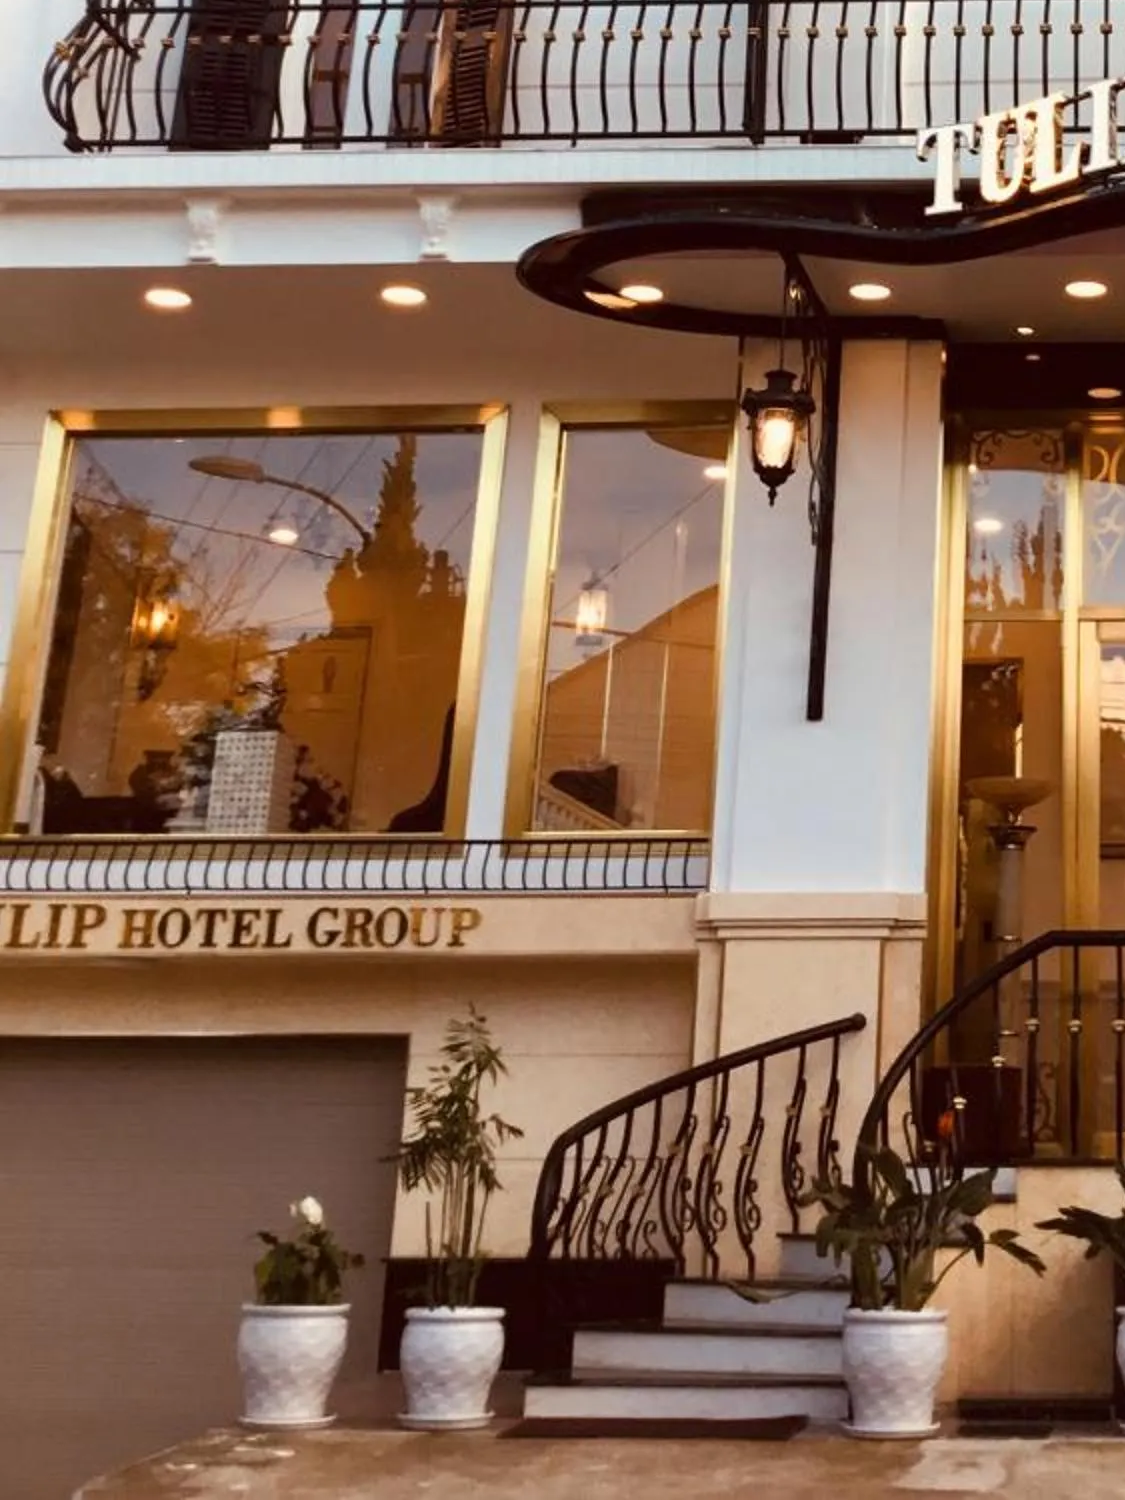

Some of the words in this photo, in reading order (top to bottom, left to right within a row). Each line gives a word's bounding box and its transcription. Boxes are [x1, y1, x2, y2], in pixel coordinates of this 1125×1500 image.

[0, 903, 108, 949] LIP
[117, 907, 292, 949] HOTEL
[305, 906, 483, 949] GROUP
